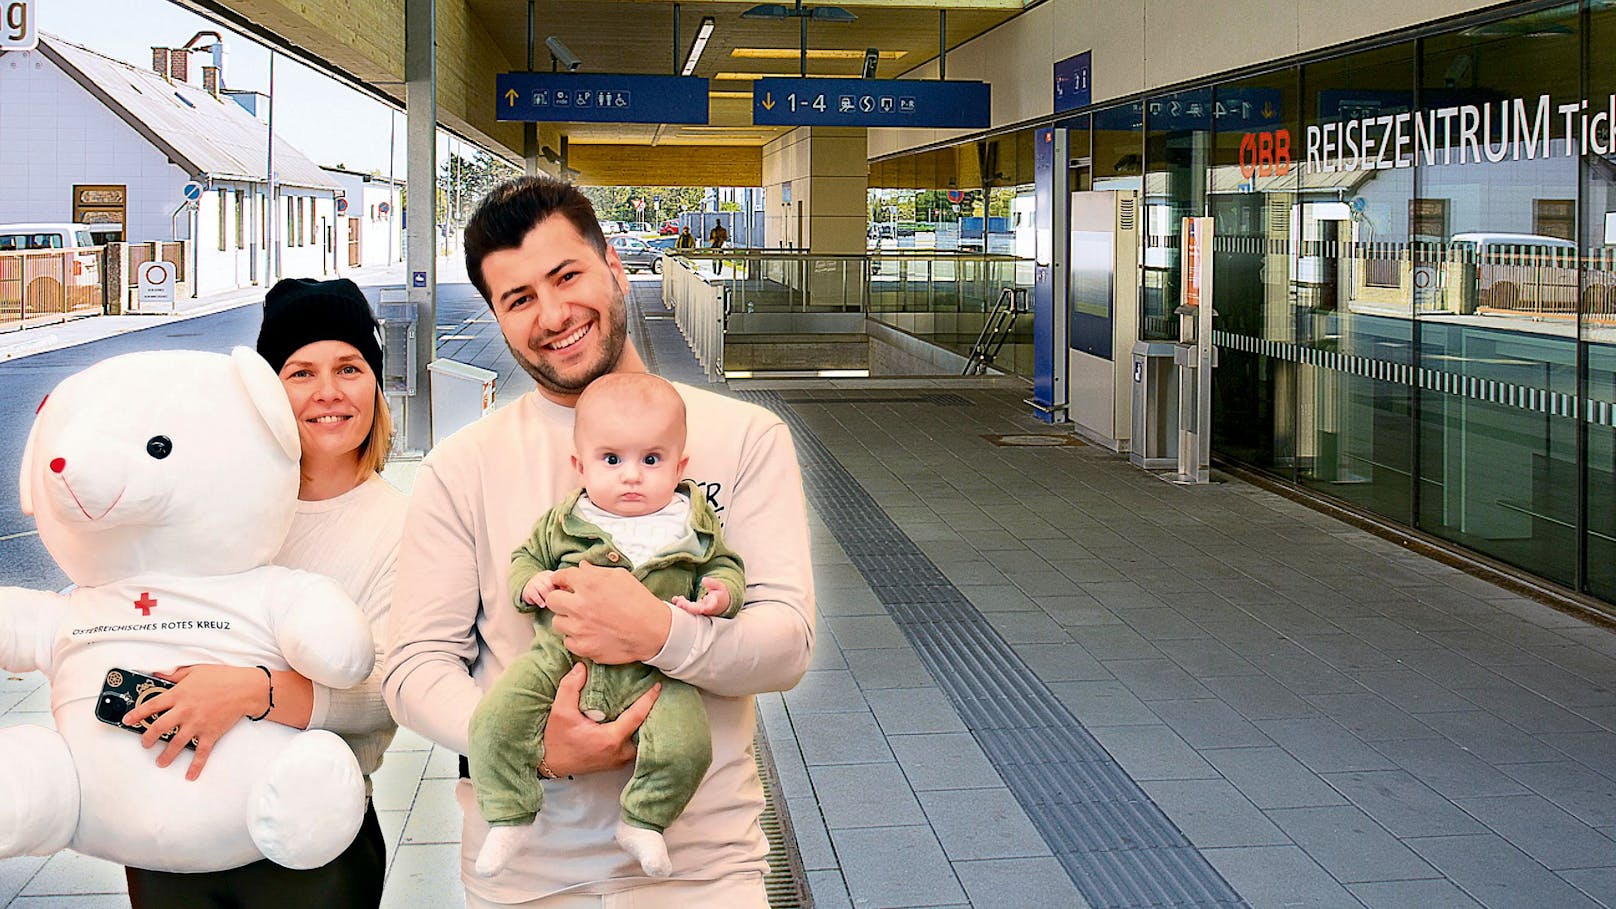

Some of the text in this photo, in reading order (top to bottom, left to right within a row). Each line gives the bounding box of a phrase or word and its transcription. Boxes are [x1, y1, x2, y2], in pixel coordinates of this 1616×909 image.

[1306, 94, 1550, 174] REISEZENTRUM
[161, 621, 193, 630] ROTES
[196, 620, 231, 630] KREUZ
